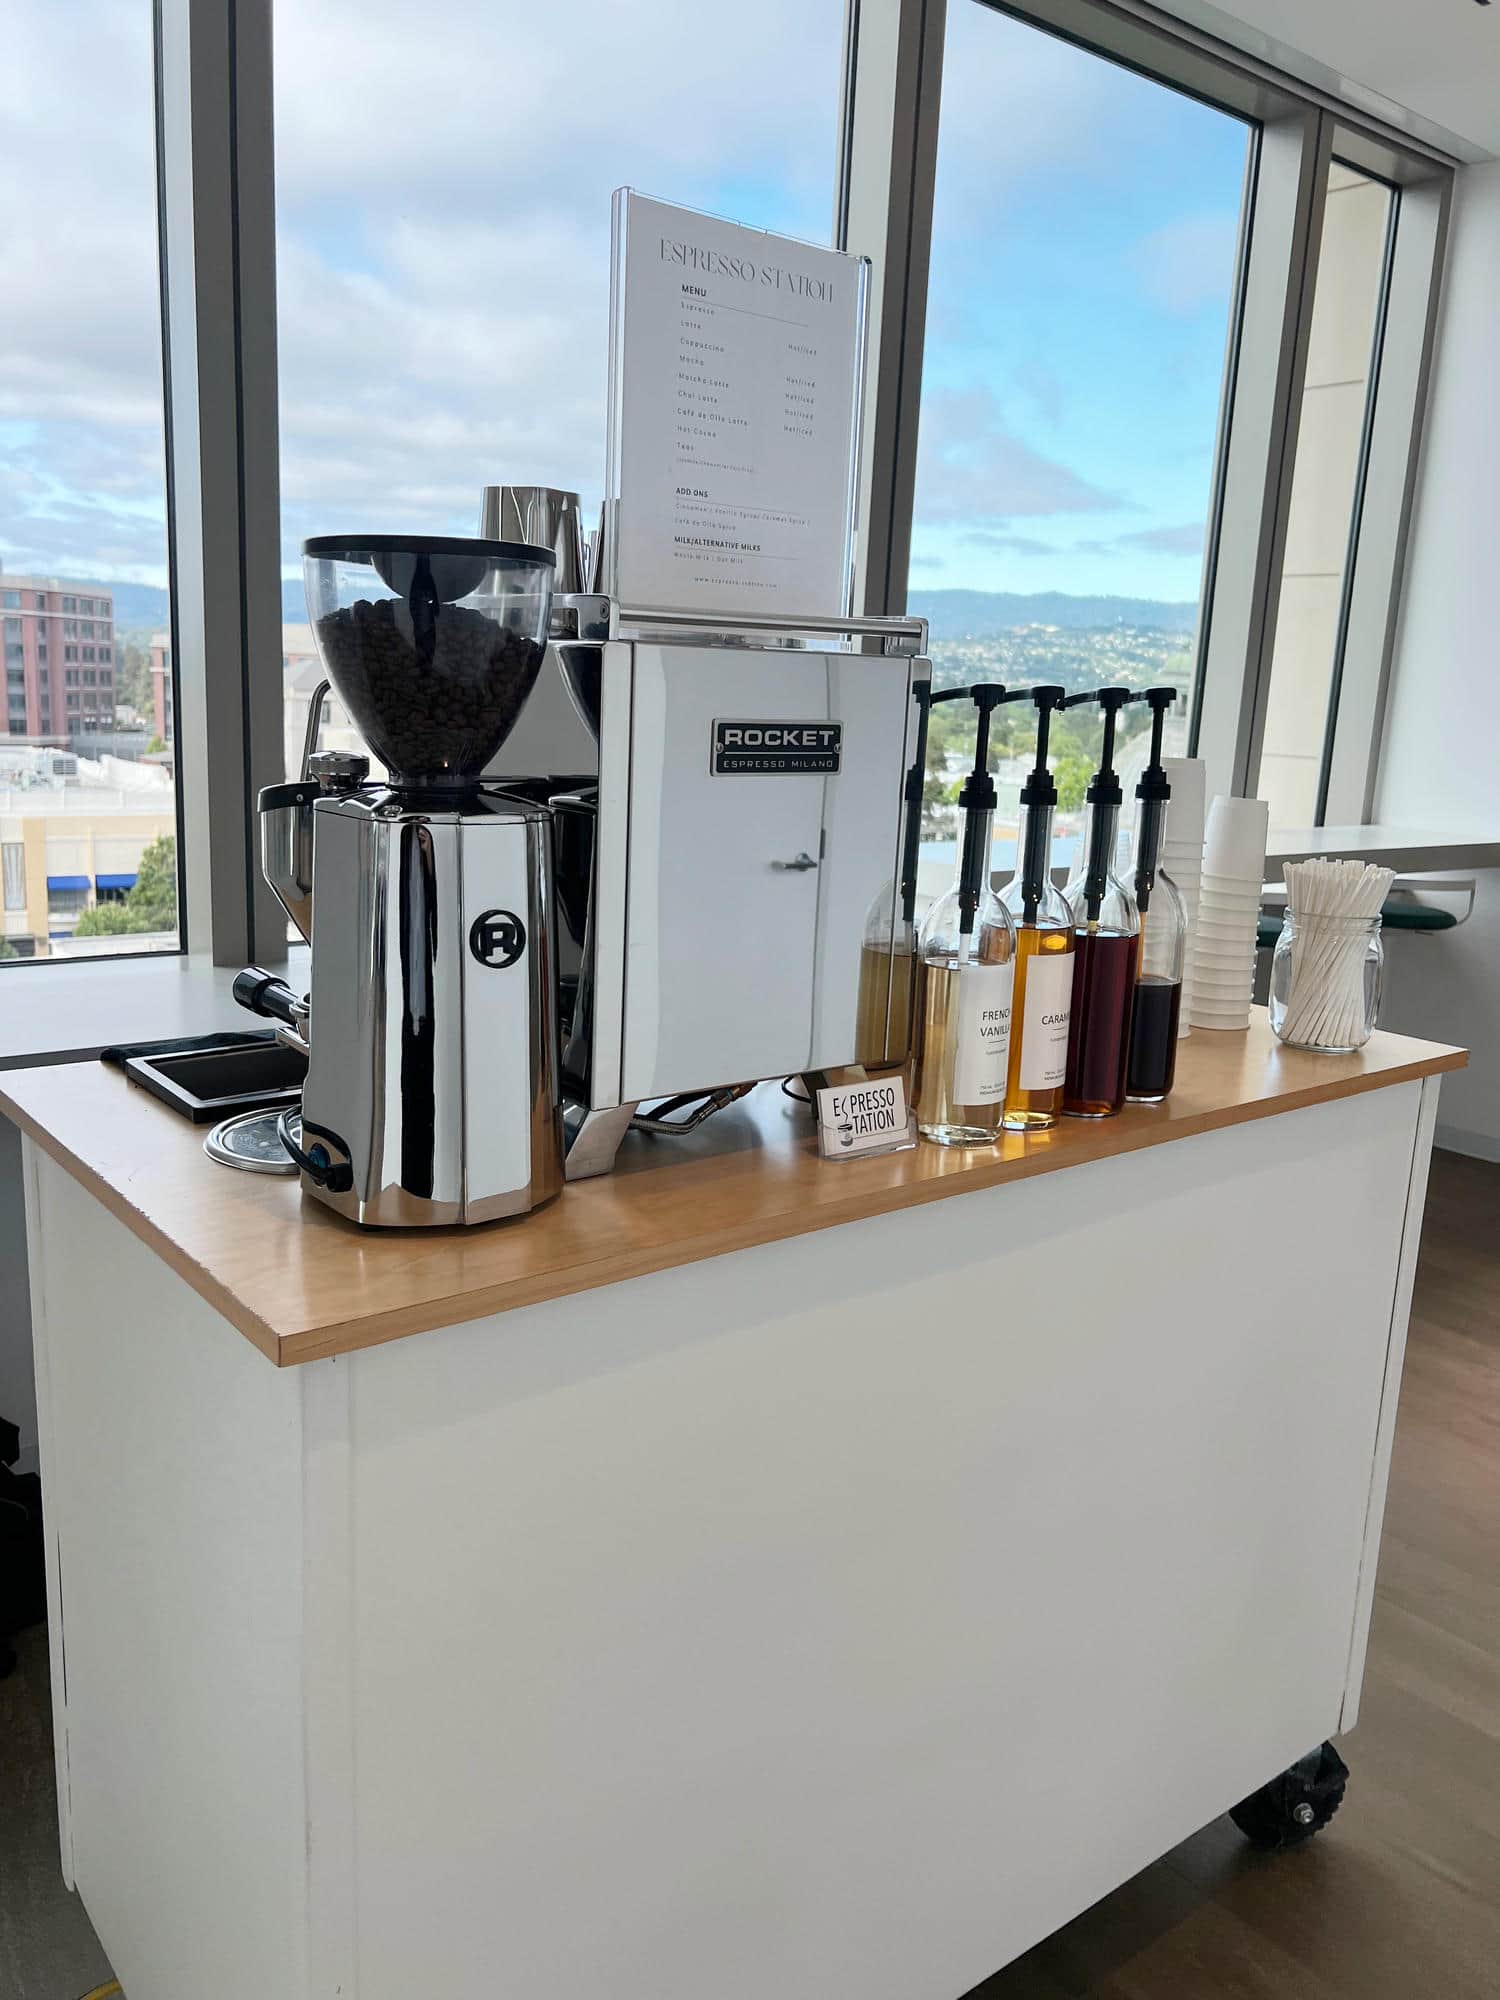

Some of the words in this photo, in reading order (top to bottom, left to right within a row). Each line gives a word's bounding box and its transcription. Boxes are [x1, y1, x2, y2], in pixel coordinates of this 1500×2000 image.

[660, 239, 755, 281] ESPRESSO
[760, 265, 833, 303] STATION
[681, 284, 707, 297] MENU
[675, 487, 692, 496] ADD
[693, 489, 709, 498] ONS
[674, 536, 740, 551] MILK/ALTERNATIVE
[740, 543, 761, 552] MILKS
[724, 729, 835, 746] ROCKET
[723, 760, 785, 768] ESPRESSO
[791, 760, 833, 768] MILANO
